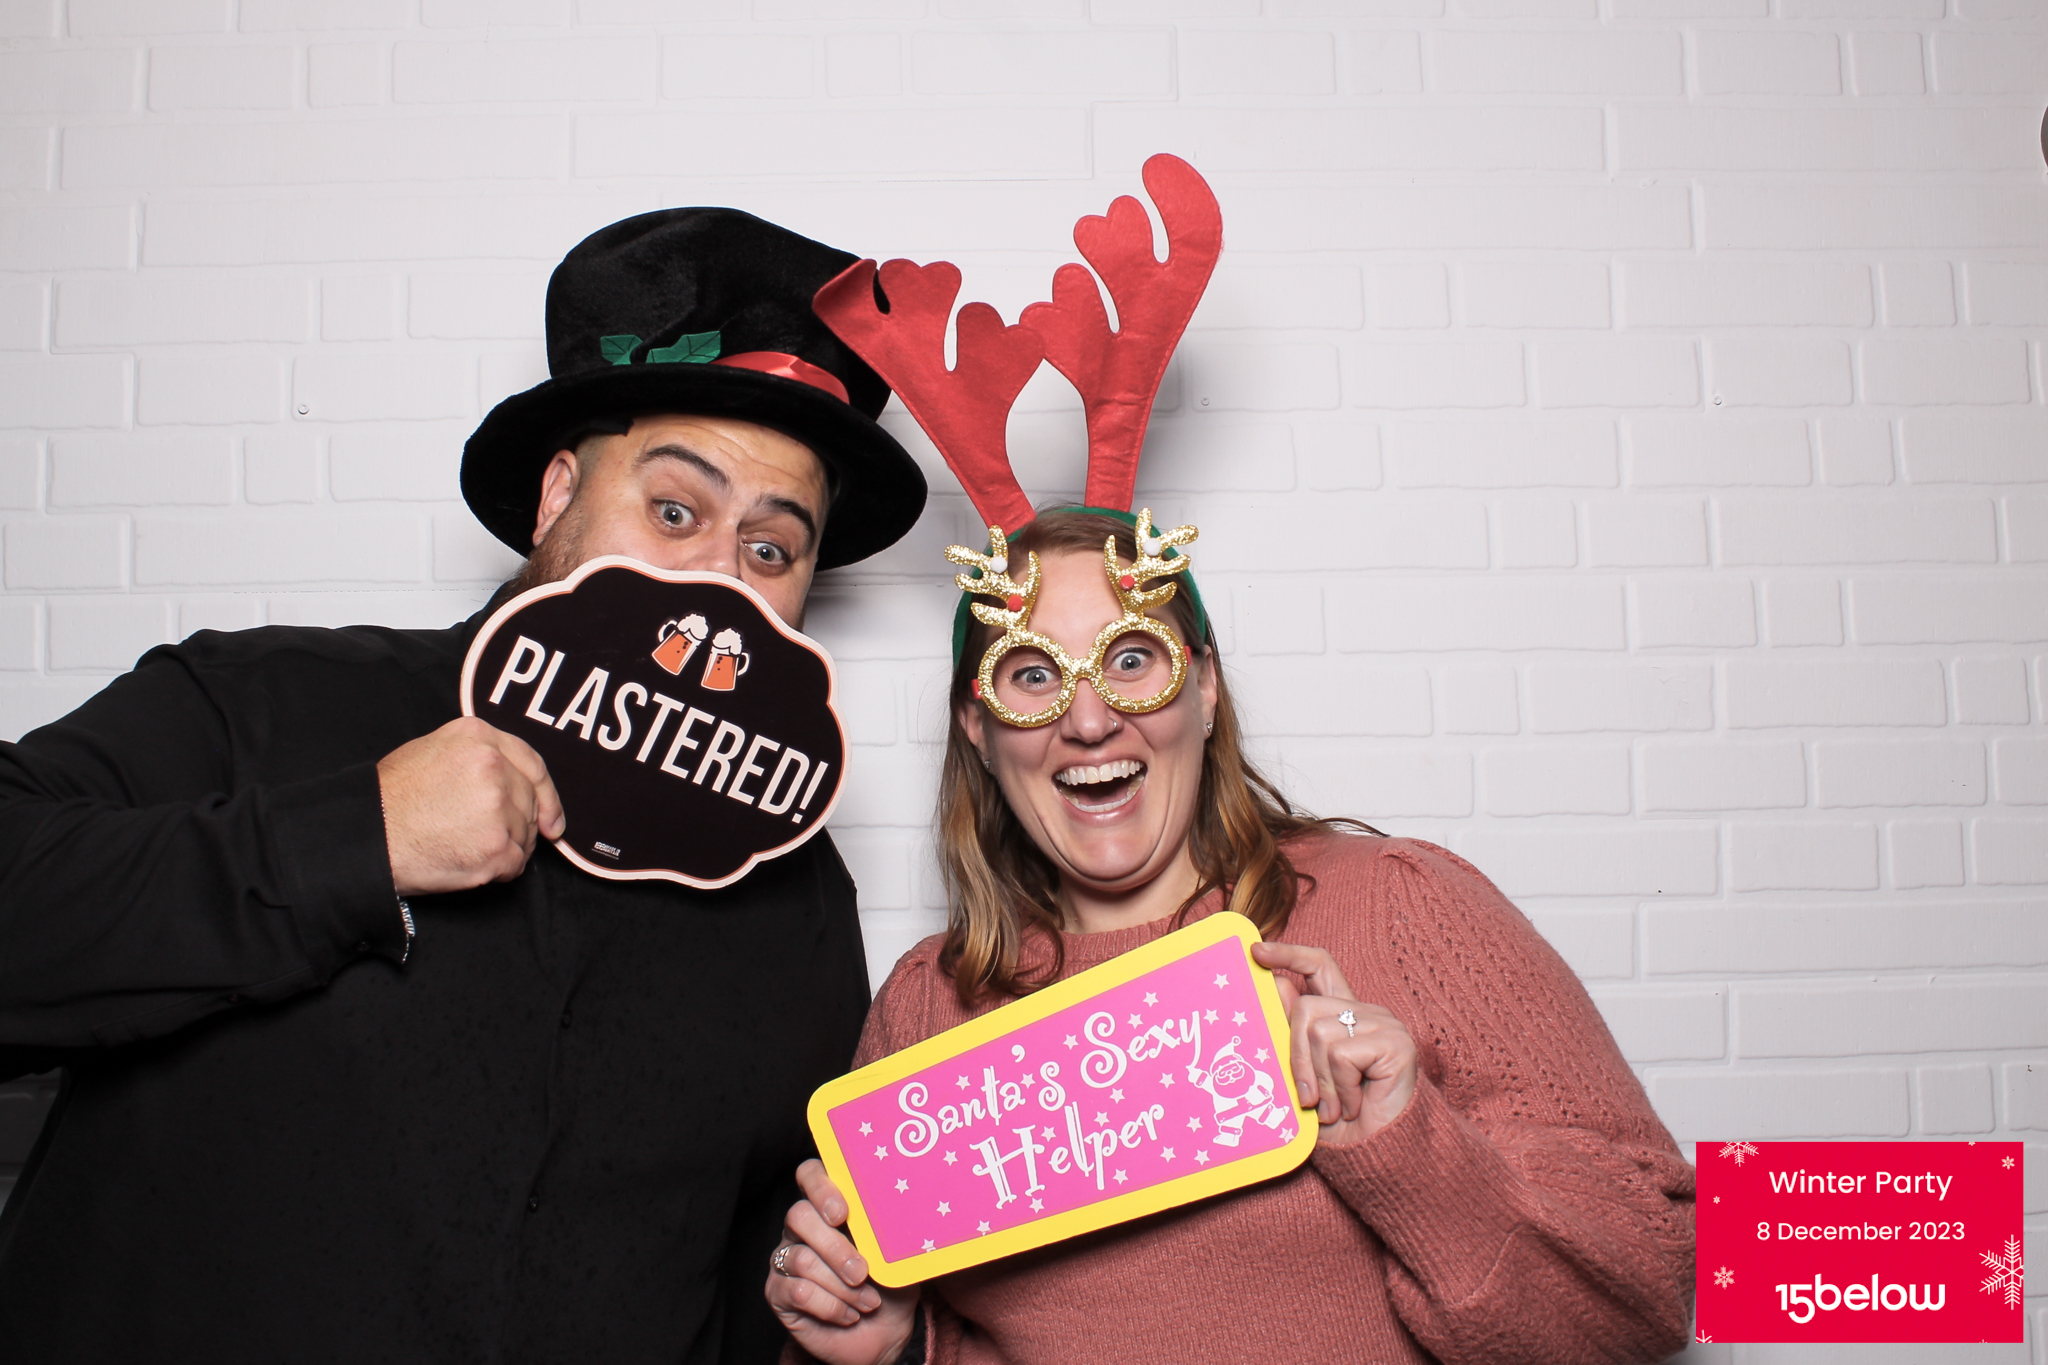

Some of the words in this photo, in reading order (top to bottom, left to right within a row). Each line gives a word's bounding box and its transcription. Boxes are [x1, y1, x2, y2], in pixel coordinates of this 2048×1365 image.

[489, 635, 828, 824] PLASTERED!
[894, 1044, 1066, 1158] Santa's
[1080, 1011, 1201, 1088] Sexy
[969, 1101, 1165, 1210] Helper
